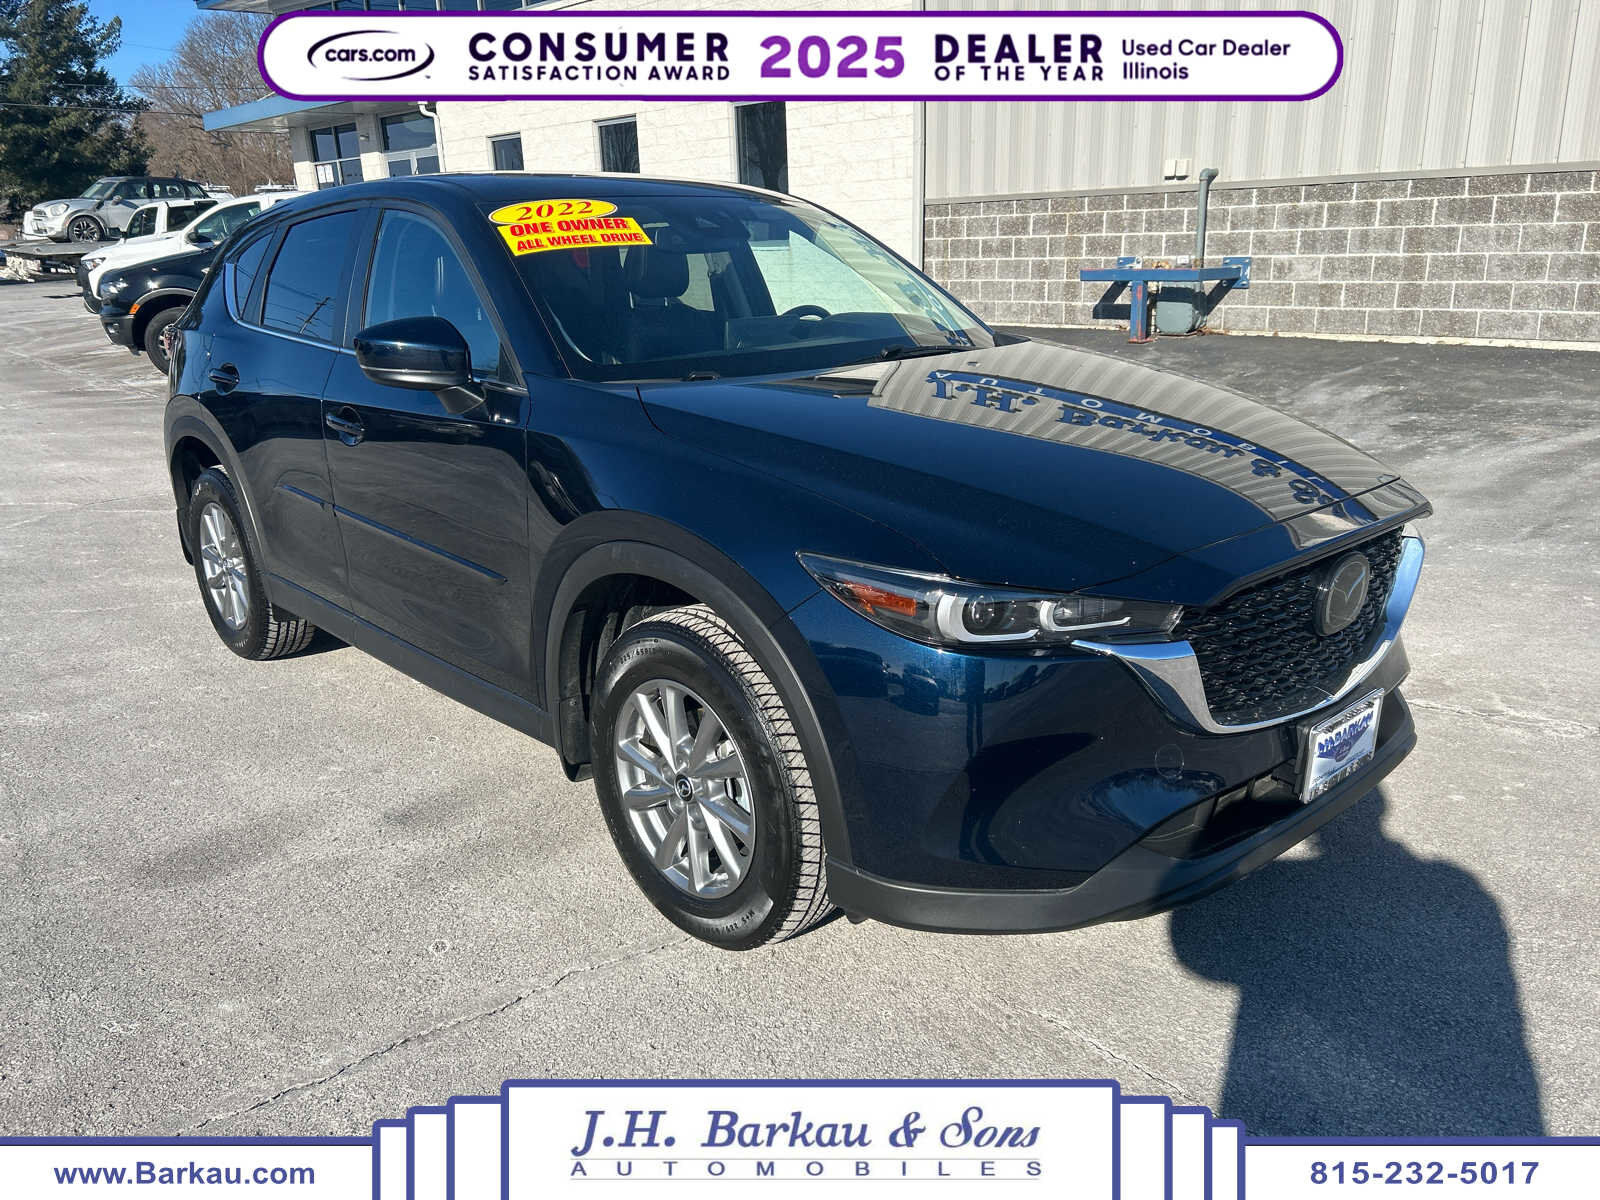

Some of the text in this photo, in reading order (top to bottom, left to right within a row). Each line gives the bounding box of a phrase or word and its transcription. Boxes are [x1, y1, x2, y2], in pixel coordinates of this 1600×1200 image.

[516, 201, 593, 221] 2022
[509, 218, 629, 237] ONE OWNER
[517, 232, 644, 252] ALL WHEEL DRIVE
